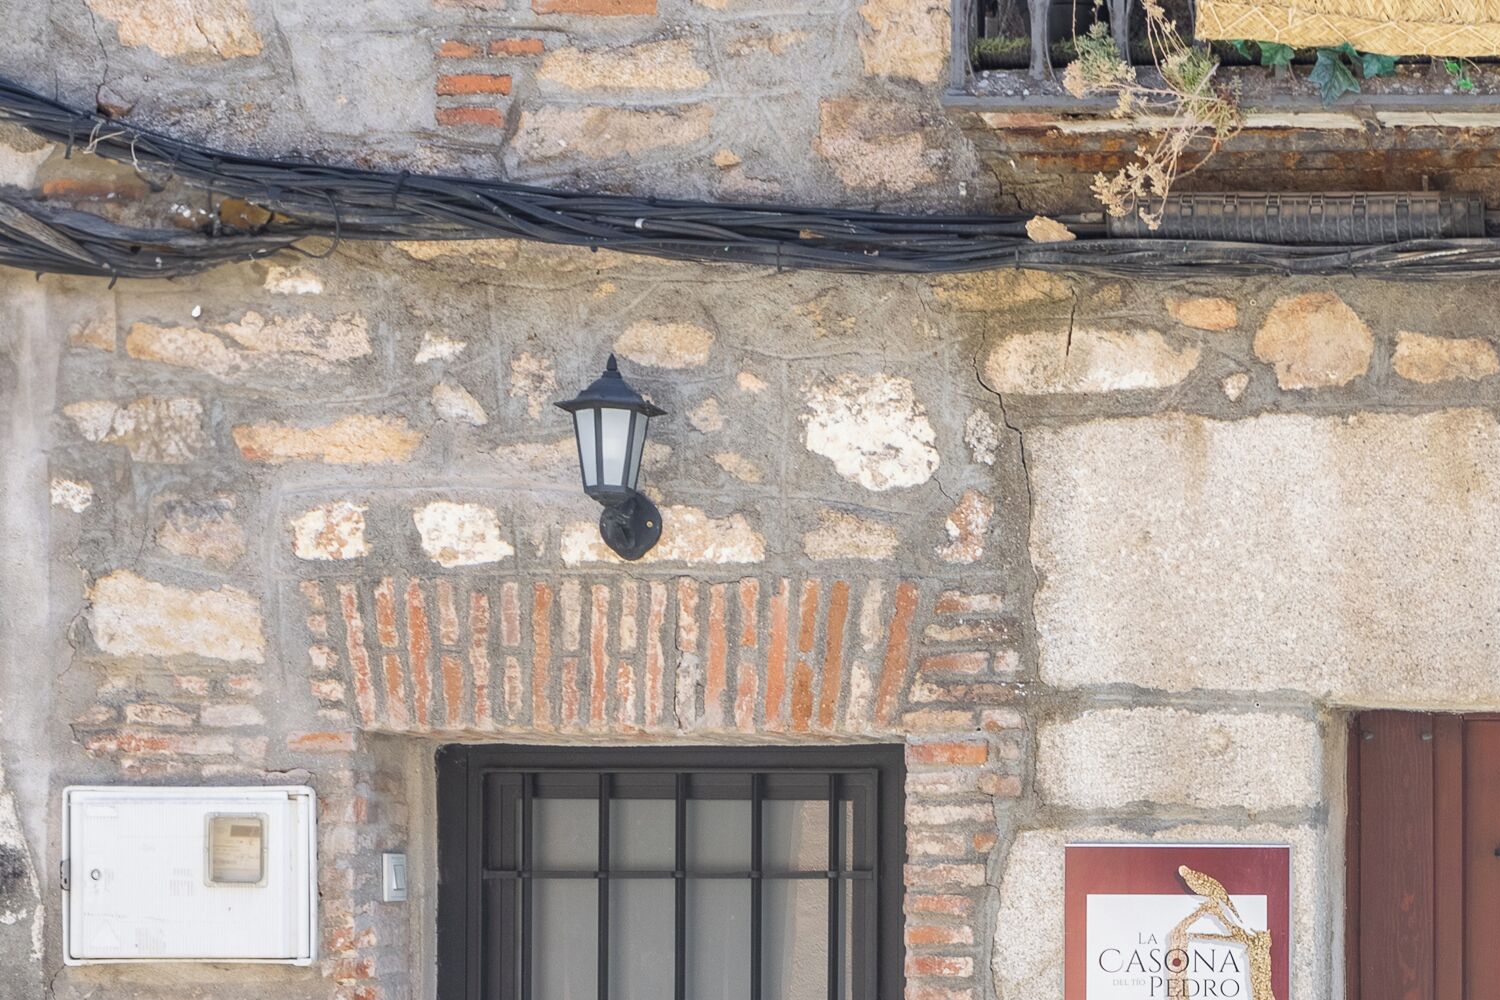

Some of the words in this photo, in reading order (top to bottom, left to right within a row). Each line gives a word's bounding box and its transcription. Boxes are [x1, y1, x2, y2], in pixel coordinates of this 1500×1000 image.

[1138, 932, 1158, 945] LA
[1098, 948, 1240, 973] CASONA
[1149, 975, 1240, 998] PEDRO
